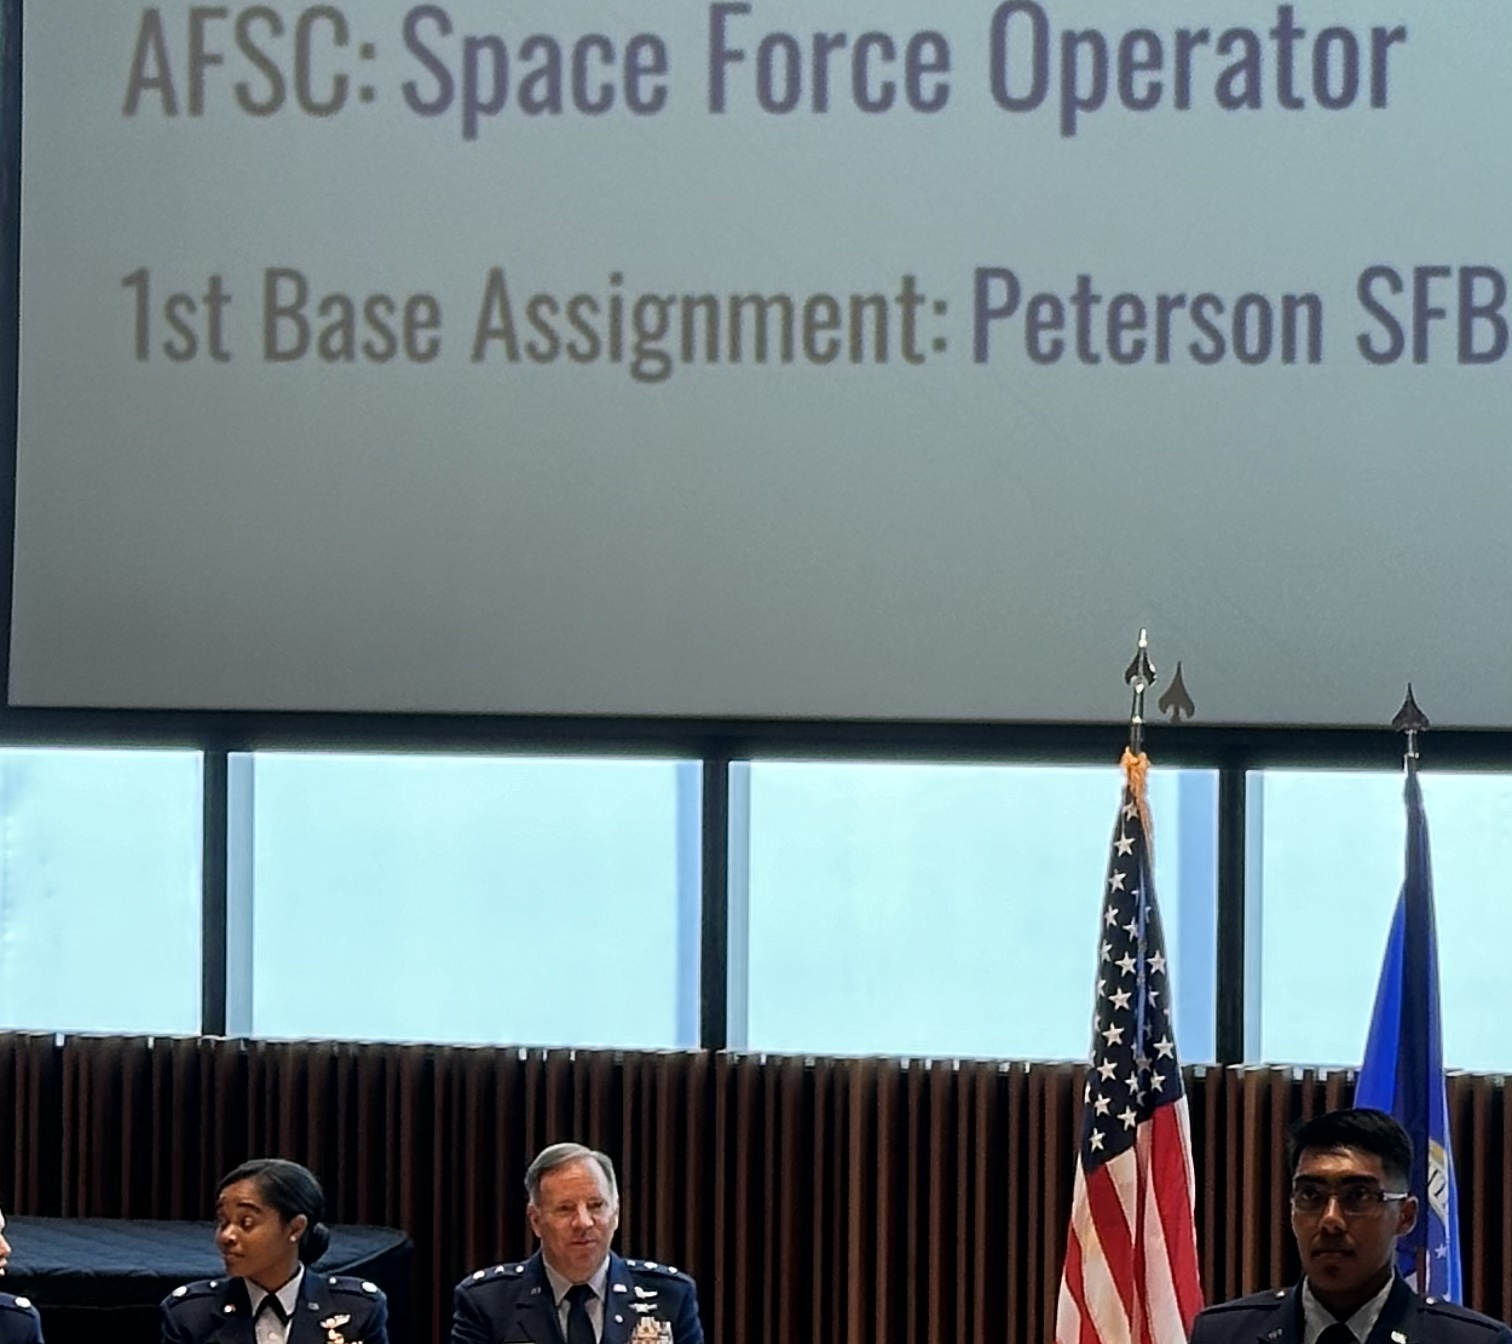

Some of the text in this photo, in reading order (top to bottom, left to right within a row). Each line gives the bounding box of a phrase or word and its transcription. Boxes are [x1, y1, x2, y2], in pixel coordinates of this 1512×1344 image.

[124, 5, 375, 116] AFSC:
[402, 4, 669, 141] Space
[708, 1, 951, 115] Force
[123, 269, 230, 361] 1st
[265, 268, 441, 362] Base
[472, 268, 947, 383] Assignment:
[974, 266, 1323, 365] Peterson
